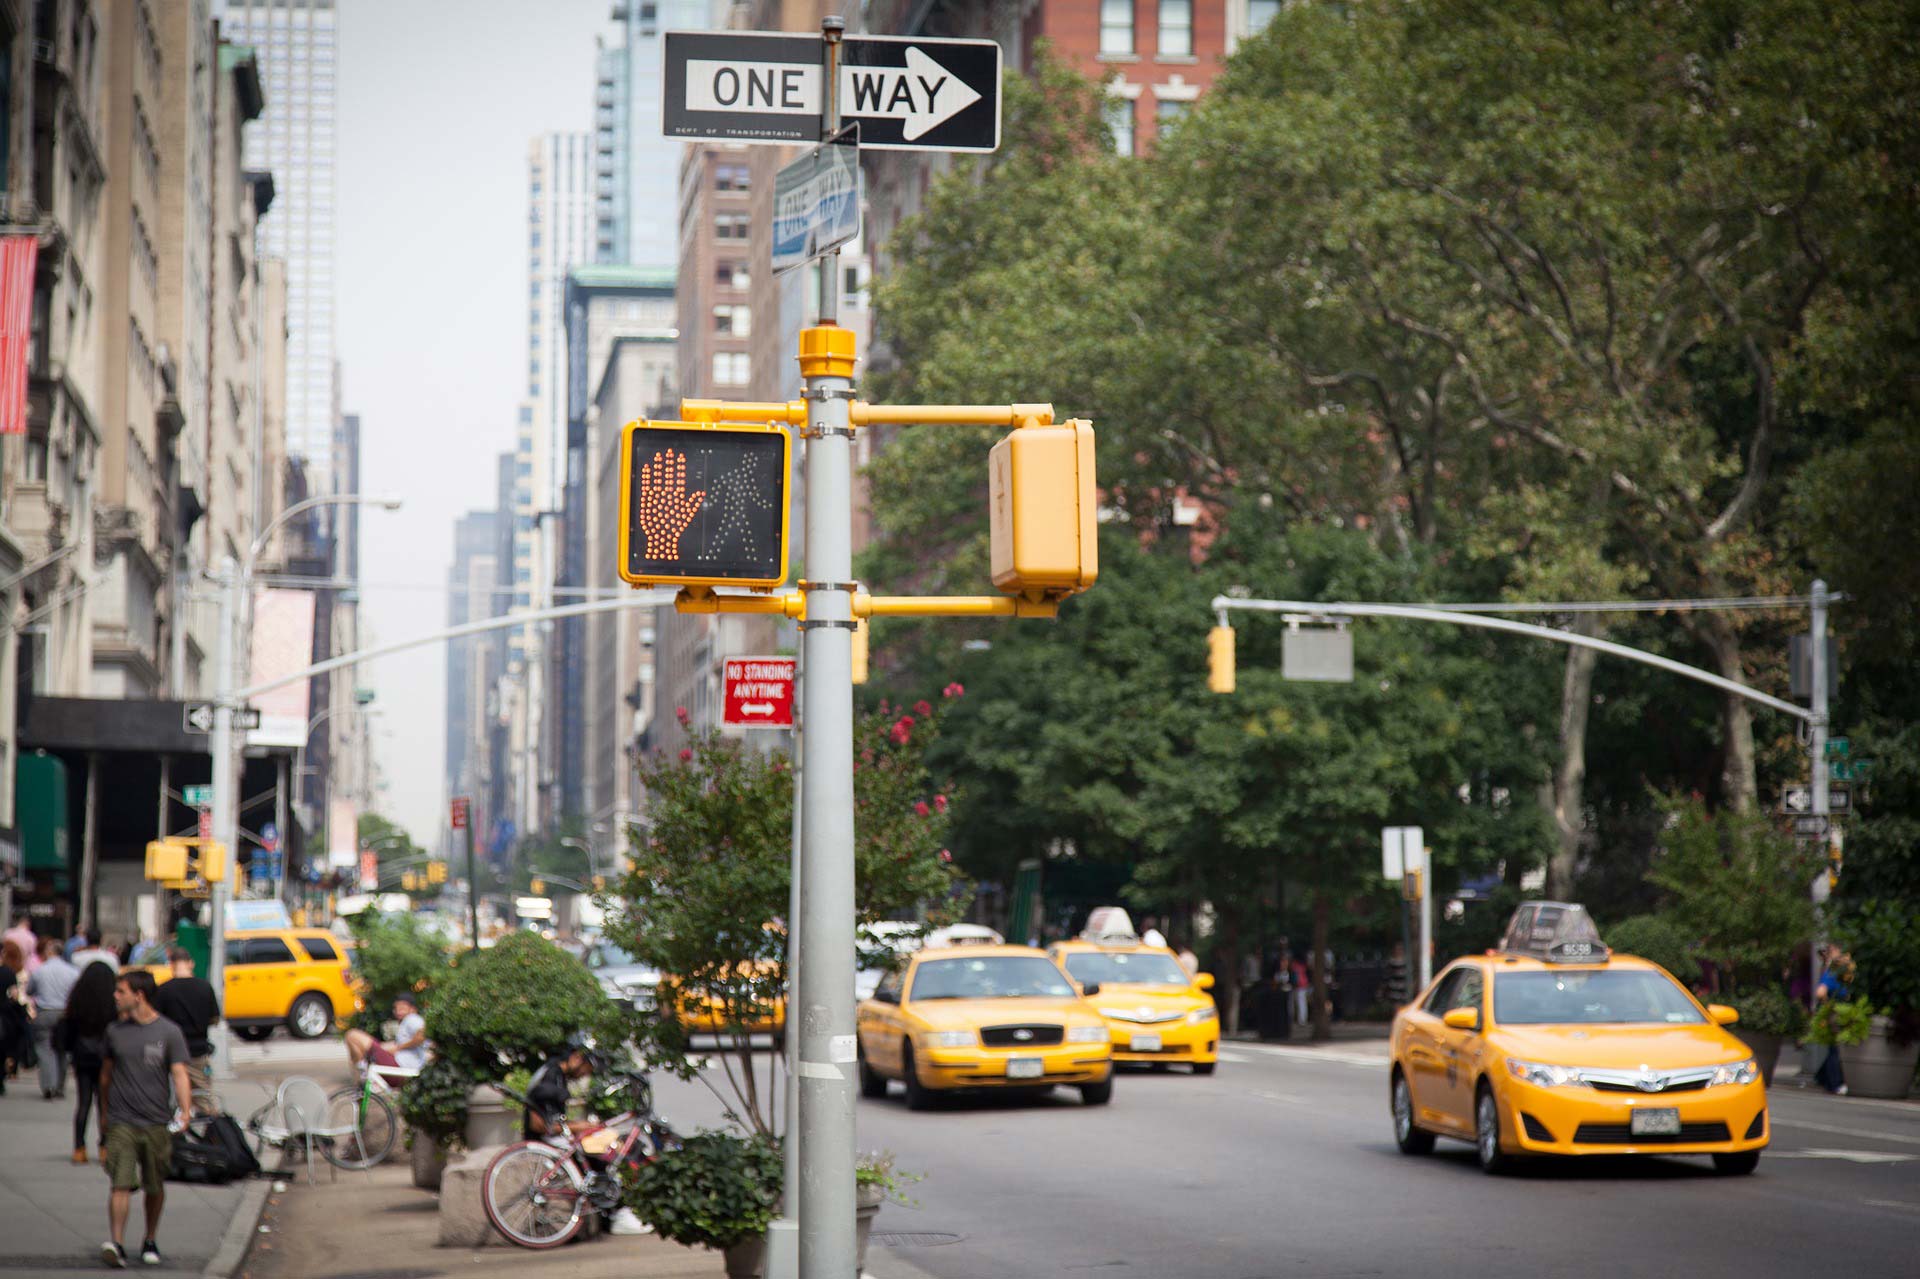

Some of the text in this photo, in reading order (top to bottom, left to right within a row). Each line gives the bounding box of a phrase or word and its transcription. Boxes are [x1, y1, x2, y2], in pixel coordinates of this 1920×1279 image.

[713, 67, 947, 114] ONE WAY
[726, 128, 803, 138] TRANSPORTATION
[784, 169, 844, 236] ONE WAY
[727, 664, 794, 681] NO STANDING
[733, 683, 785, 699] ANYTIME
